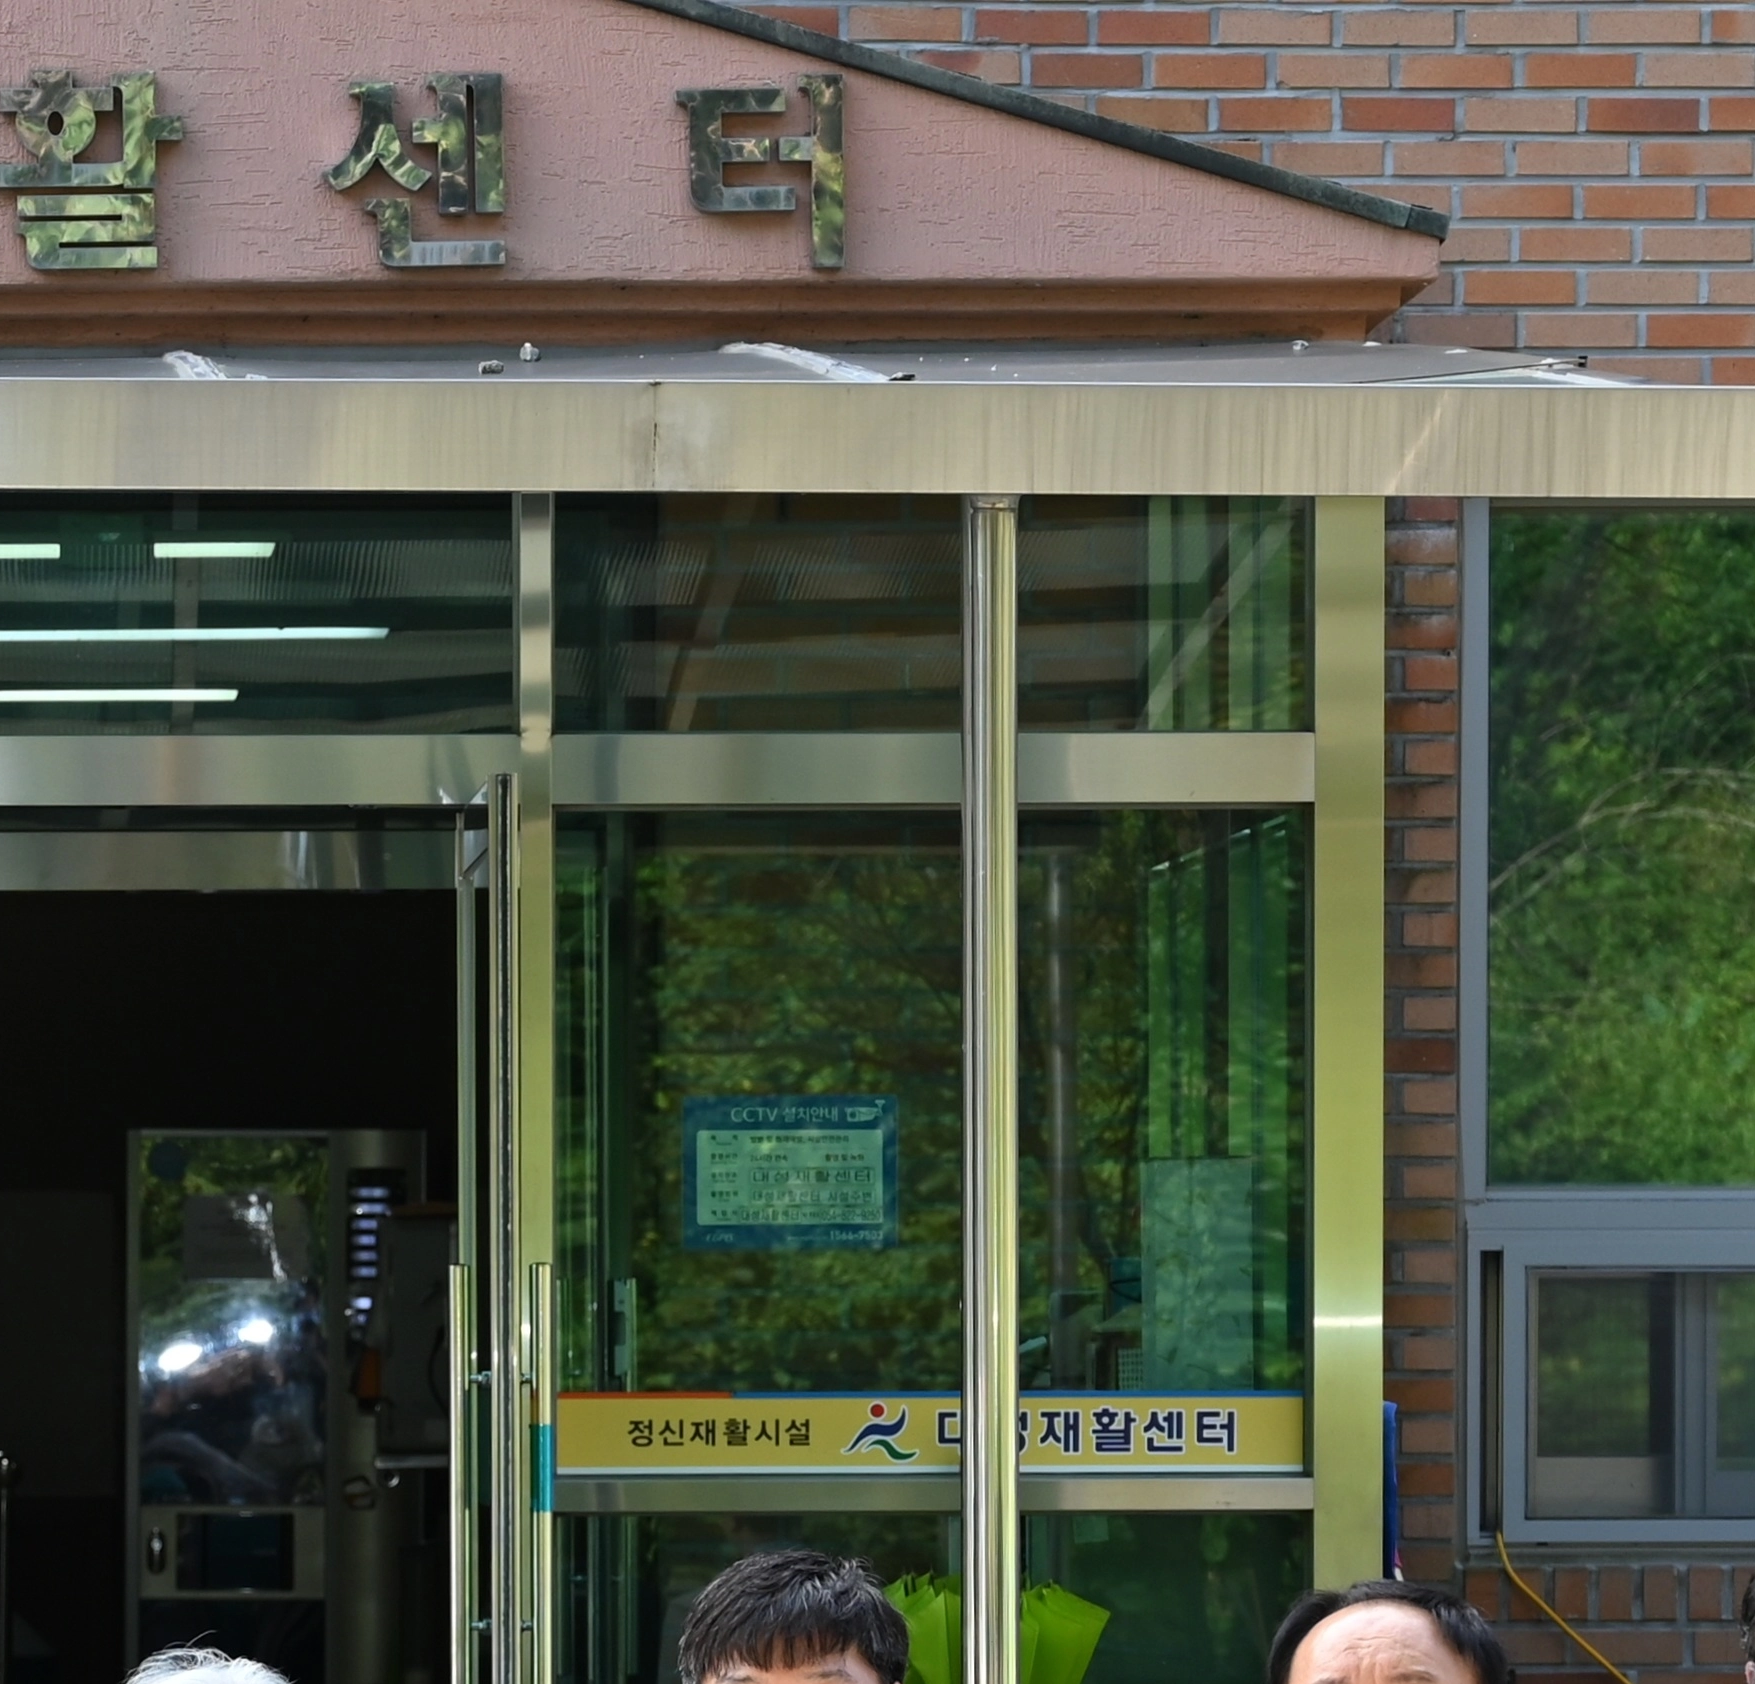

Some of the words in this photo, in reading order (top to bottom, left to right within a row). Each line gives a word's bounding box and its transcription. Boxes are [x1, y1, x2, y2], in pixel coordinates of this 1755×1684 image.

[730, 1107, 779, 1122] CCTV
[782, 1106, 839, 1123] 설치안내
[627, 1418, 811, 1448] 정신재활시설
[936, 1406, 1237, 1456] 재활센터
